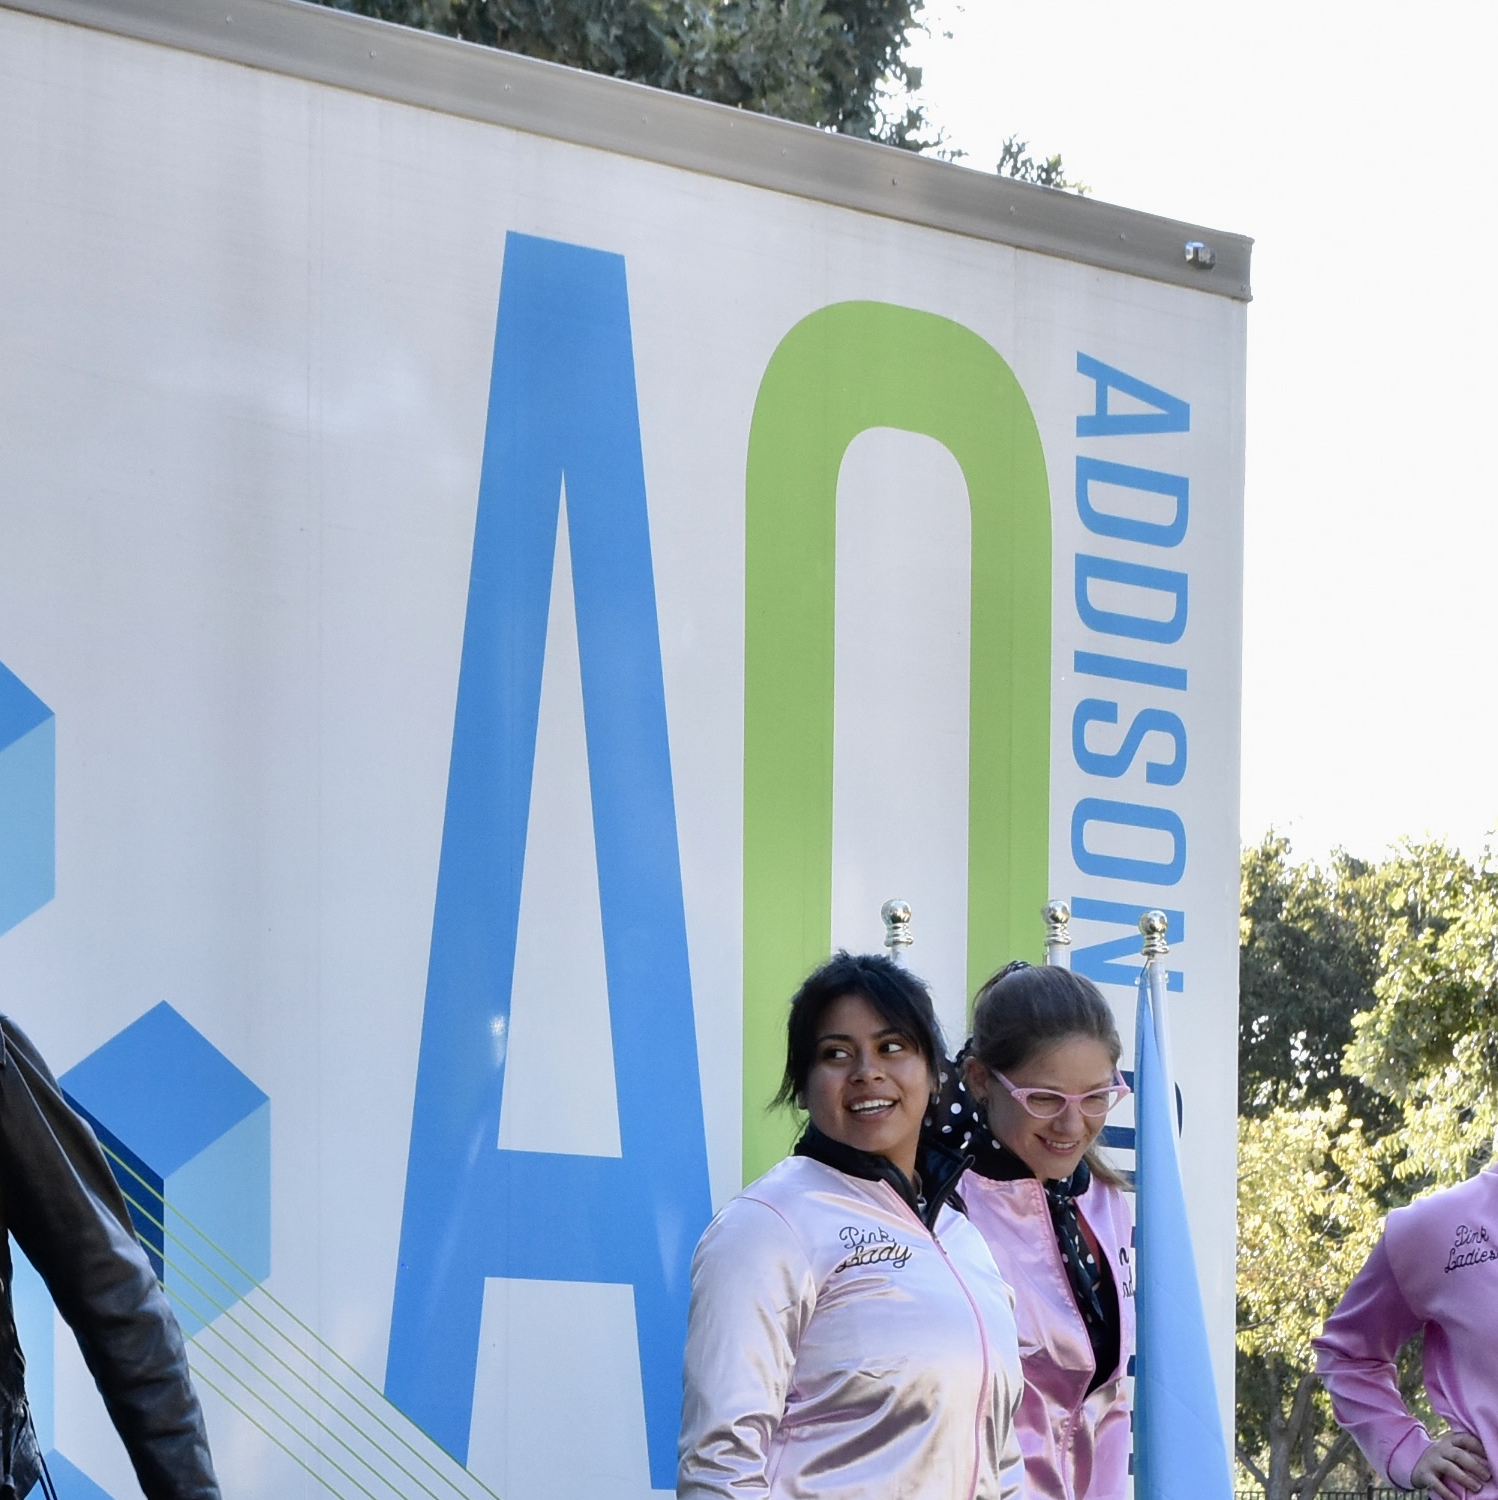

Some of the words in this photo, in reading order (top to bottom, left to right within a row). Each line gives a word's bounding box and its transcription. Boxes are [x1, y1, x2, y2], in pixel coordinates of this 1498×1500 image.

[1069, 350, 1191, 994] ADDISON
[839, 1226, 895, 1249] Pink
[1454, 1225, 1489, 1247] Pink
[835, 1243, 912, 1273] Lady
[1444, 1248, 1498, 1273] Ladies
